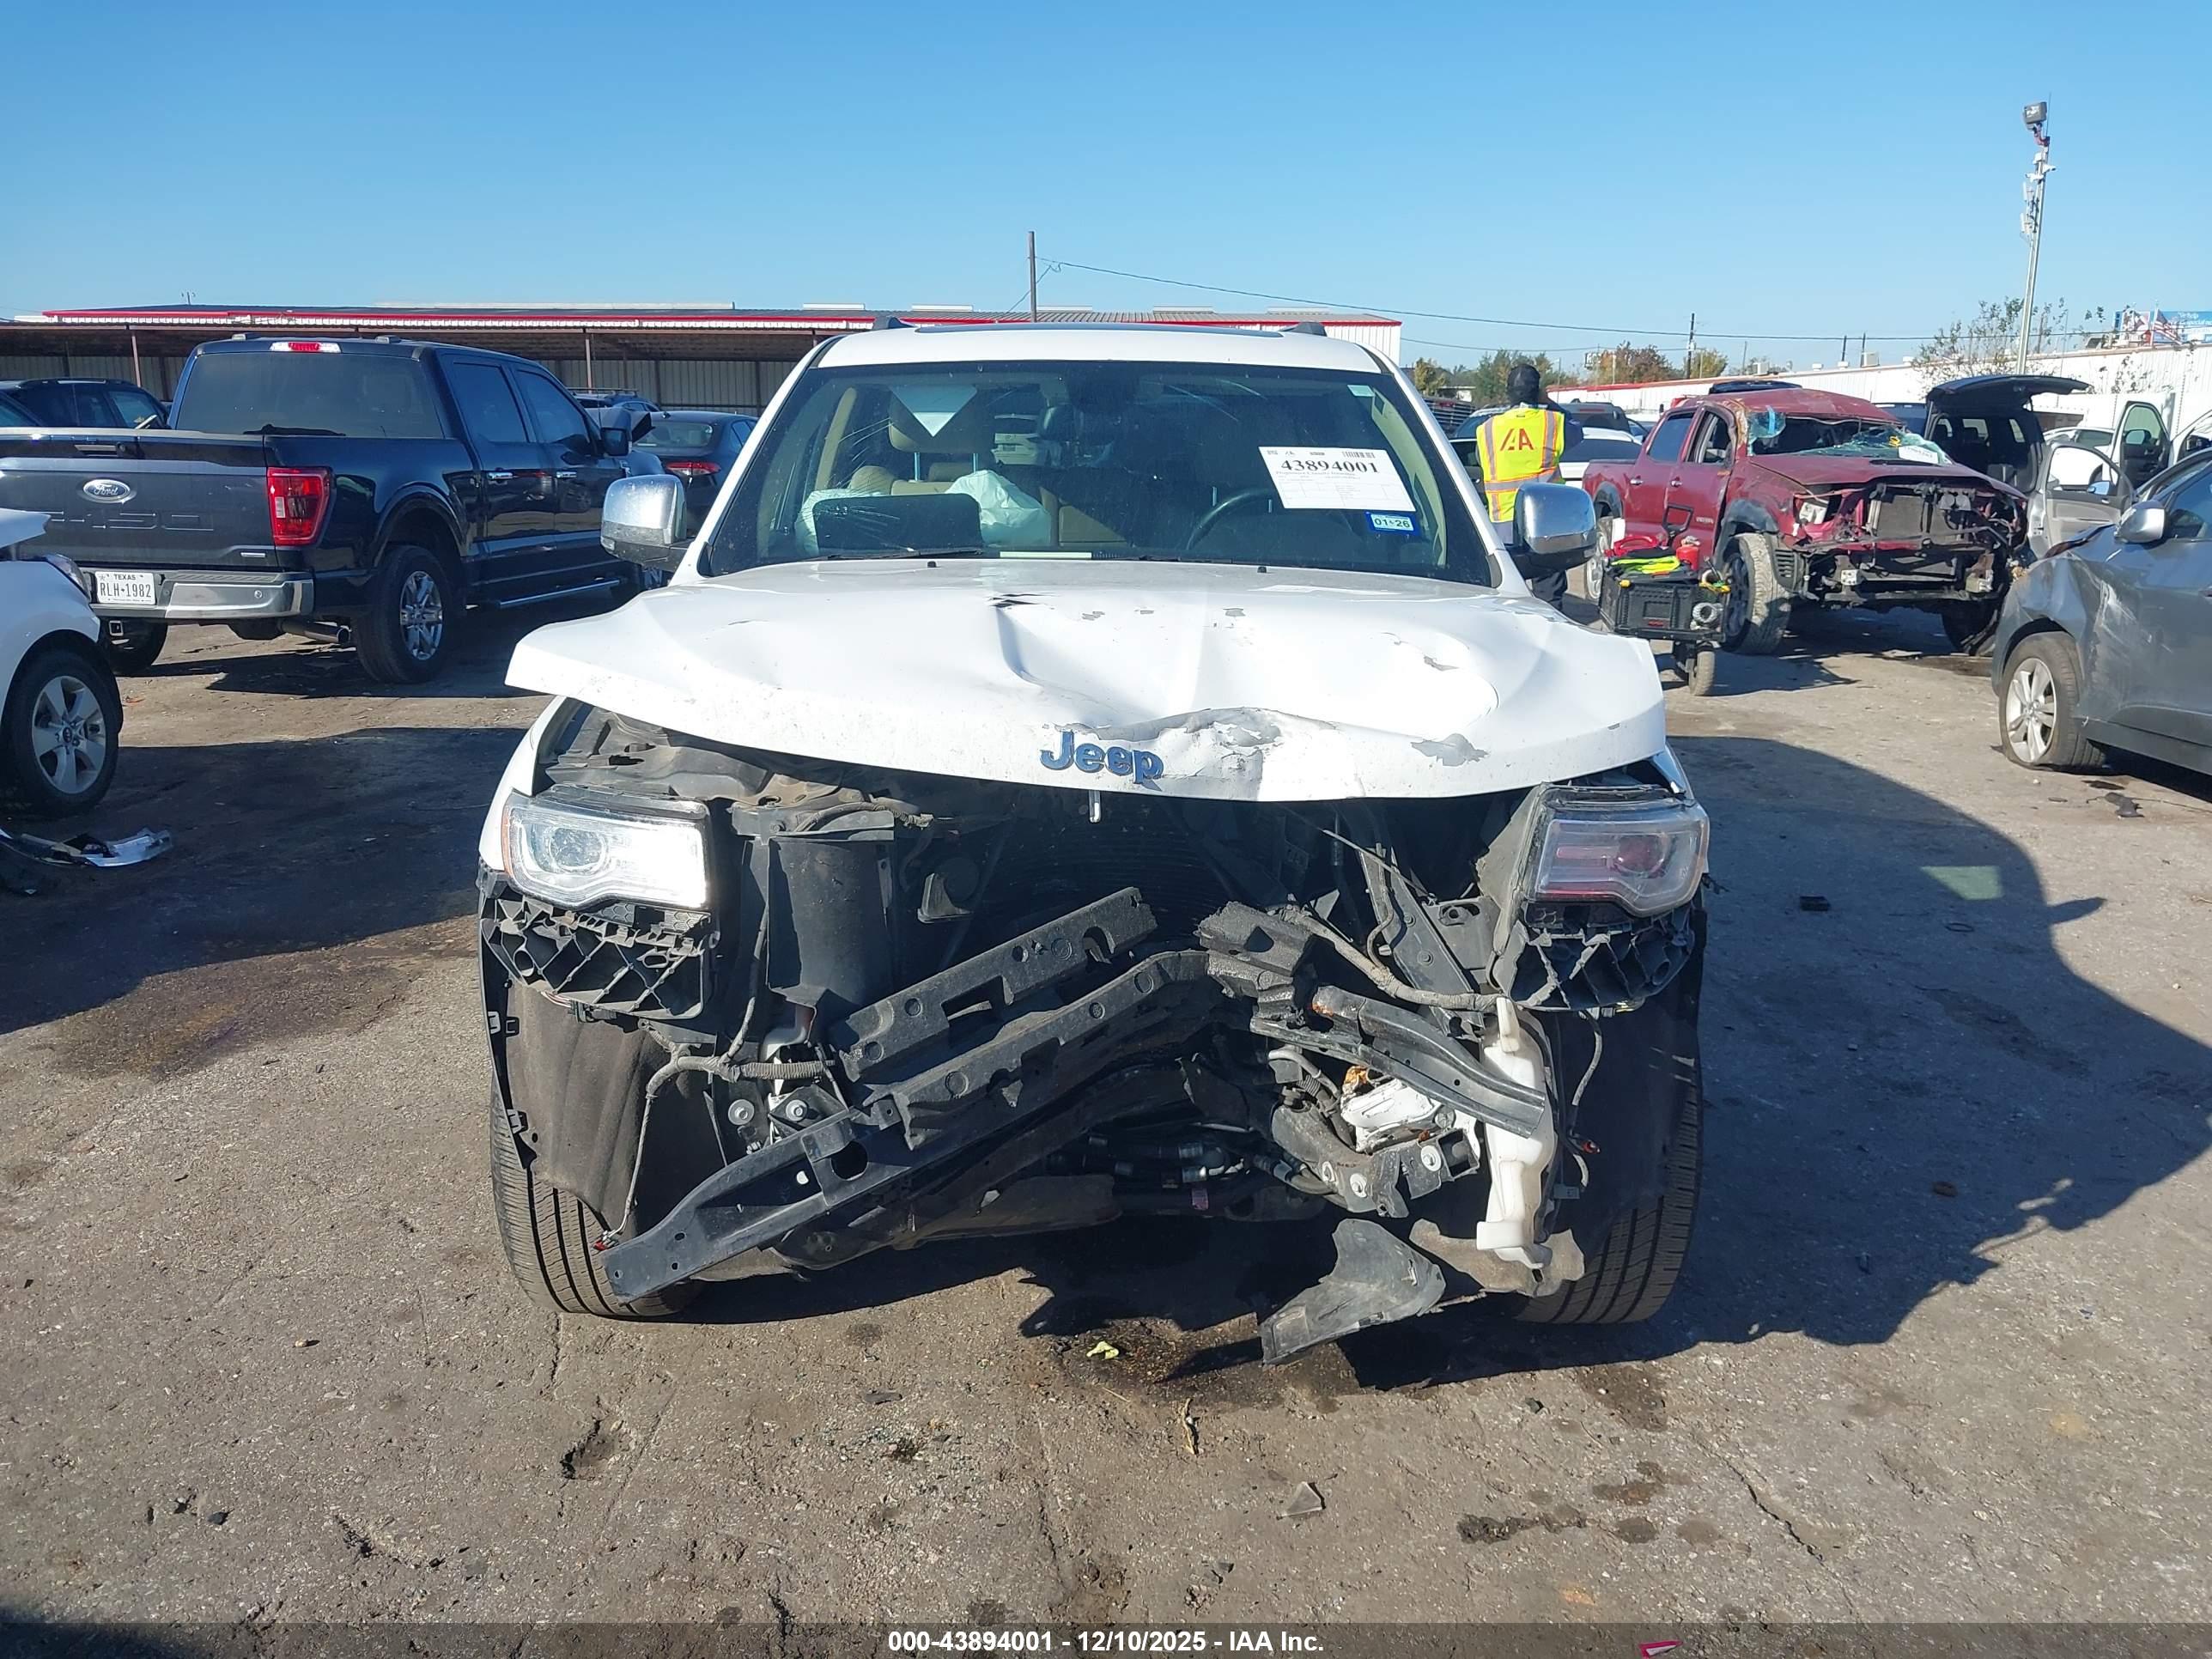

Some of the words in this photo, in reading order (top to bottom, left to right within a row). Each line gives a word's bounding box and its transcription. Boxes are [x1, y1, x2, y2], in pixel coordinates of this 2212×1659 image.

[1281, 459, 1379, 473] 43894001
[94, 483, 118, 495] Ford
[1040, 729, 1164, 784] Jeep
